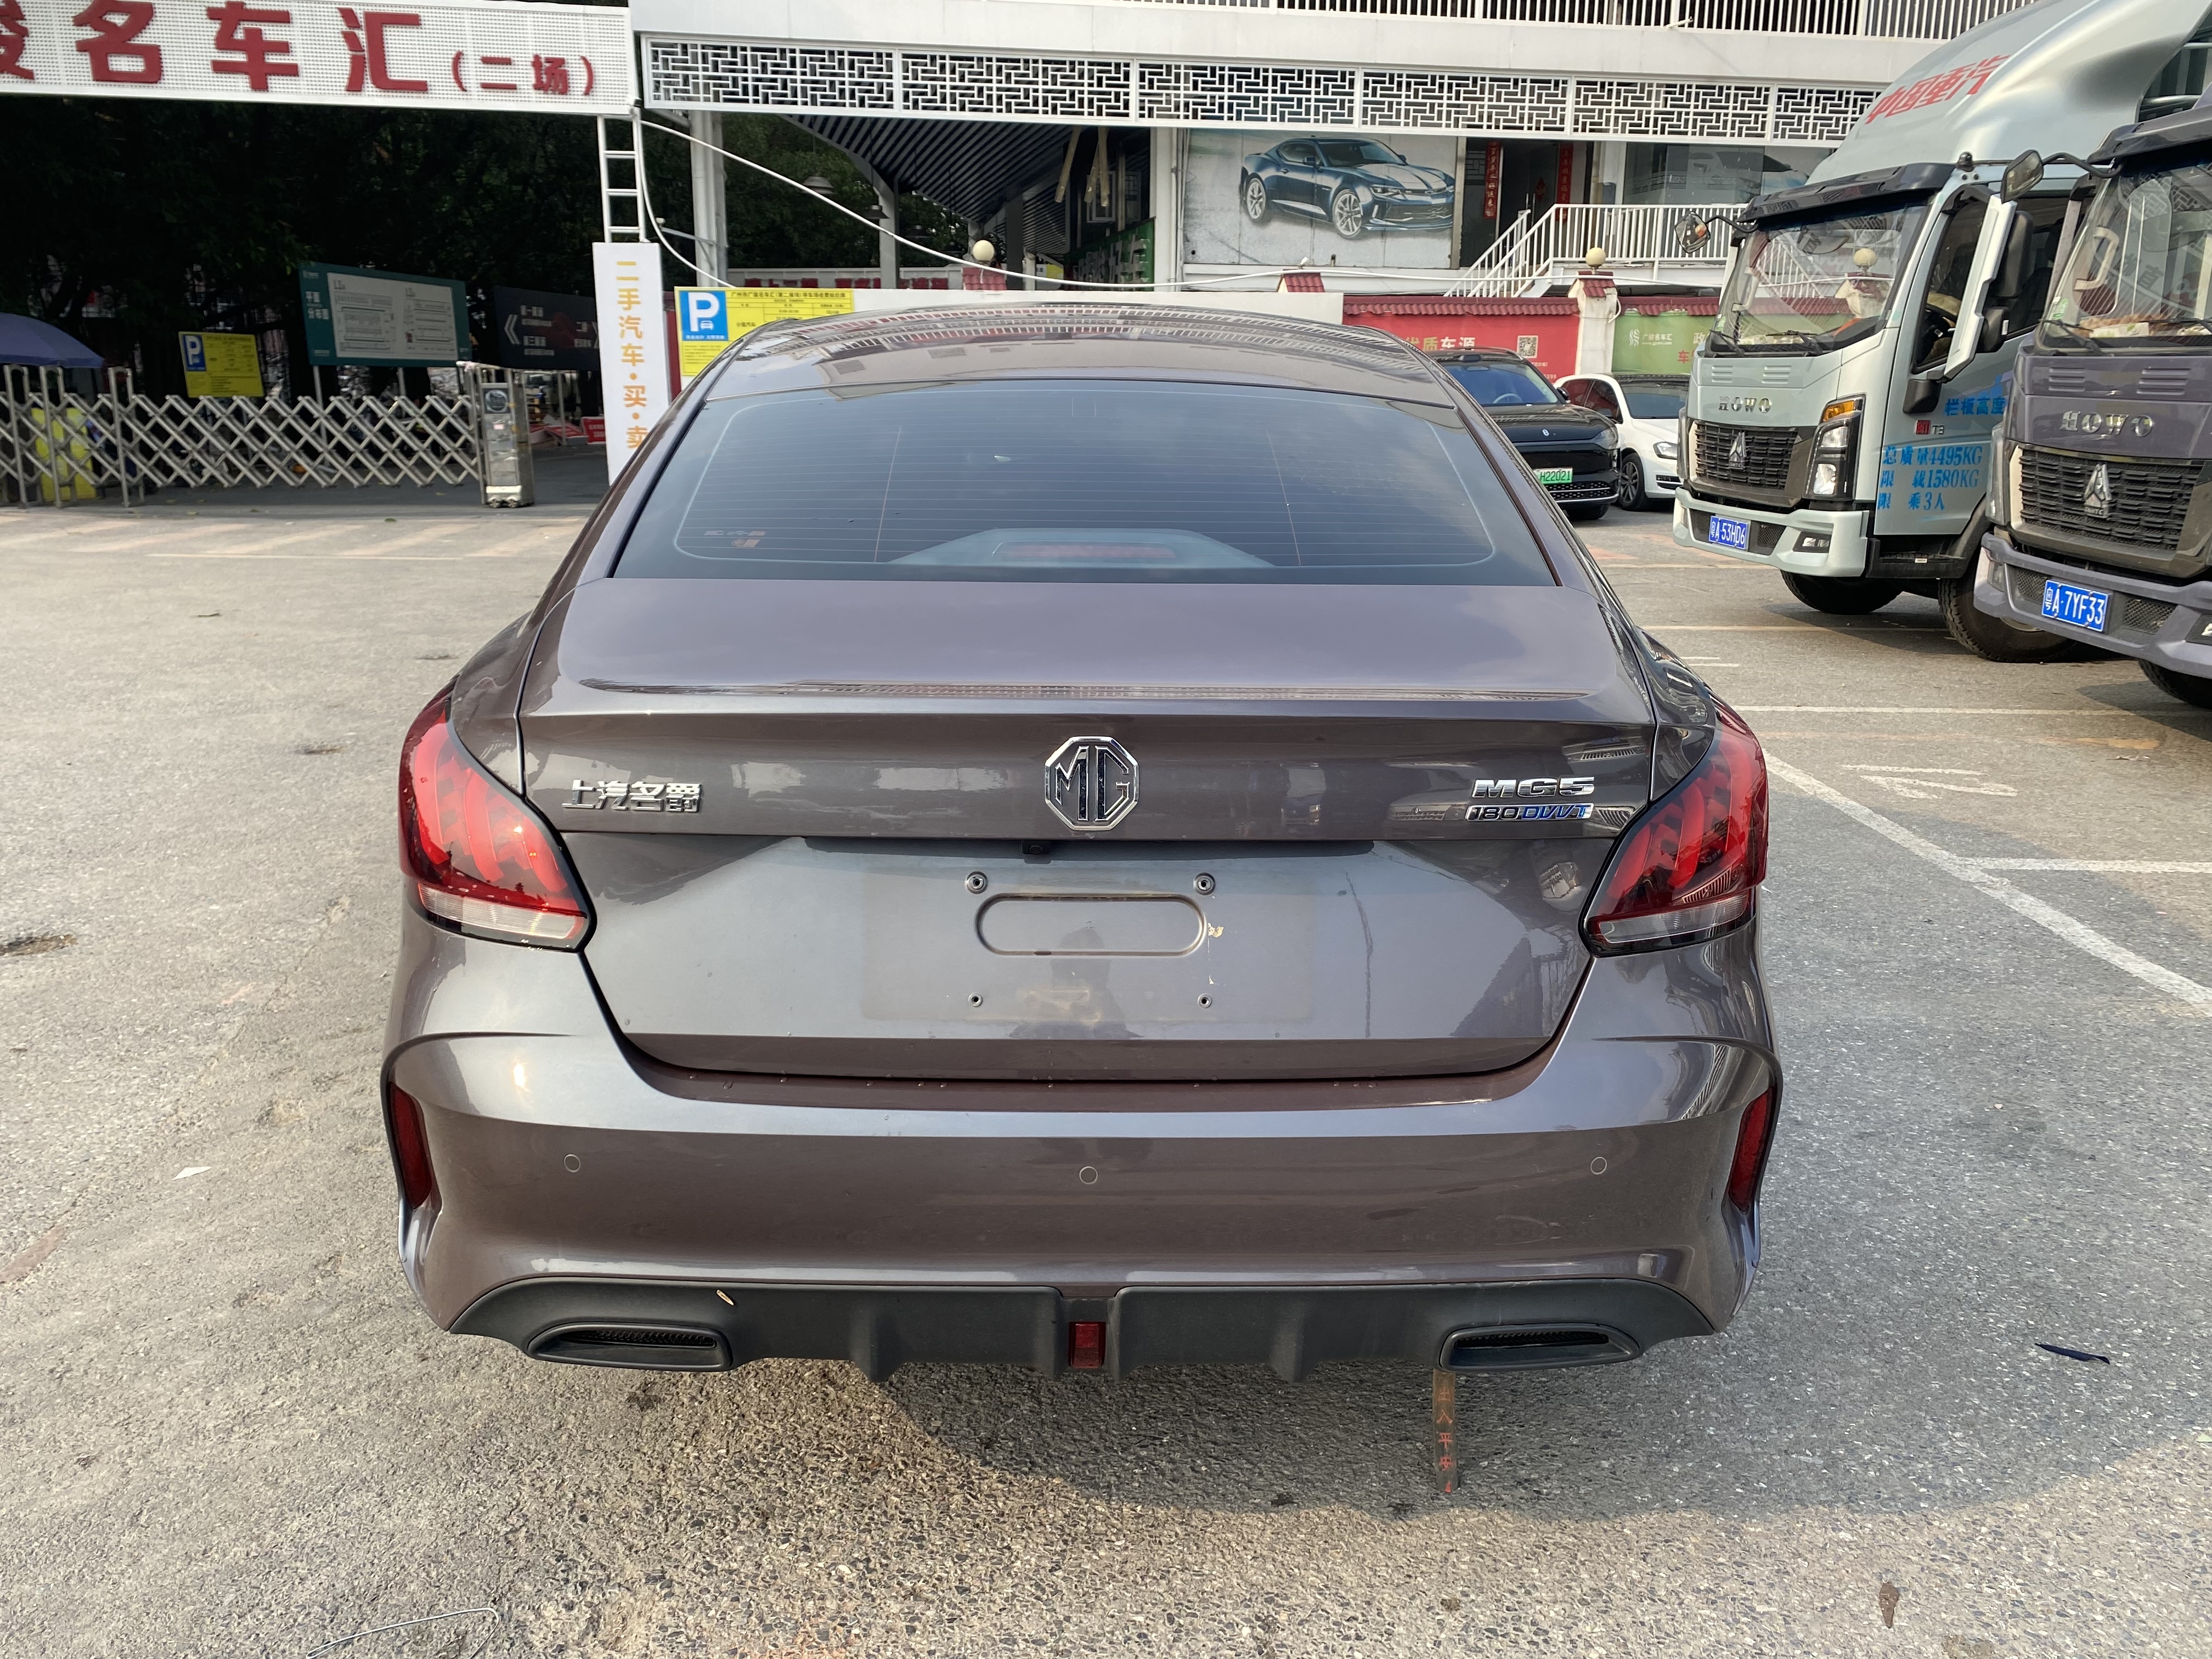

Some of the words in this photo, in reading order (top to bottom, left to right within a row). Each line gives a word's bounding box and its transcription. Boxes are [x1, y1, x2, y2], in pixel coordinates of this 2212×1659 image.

[1865, 55, 2010, 125] 中国重汽
[688, 292, 720, 331] P
[1719, 396, 1772, 413] HOWO
[2060, 410, 2155, 437] HOWO
[561, 780, 702, 812] 上汽名爵
[1054, 746, 1130, 822] MG
[1472, 776, 1595, 798] MG5
